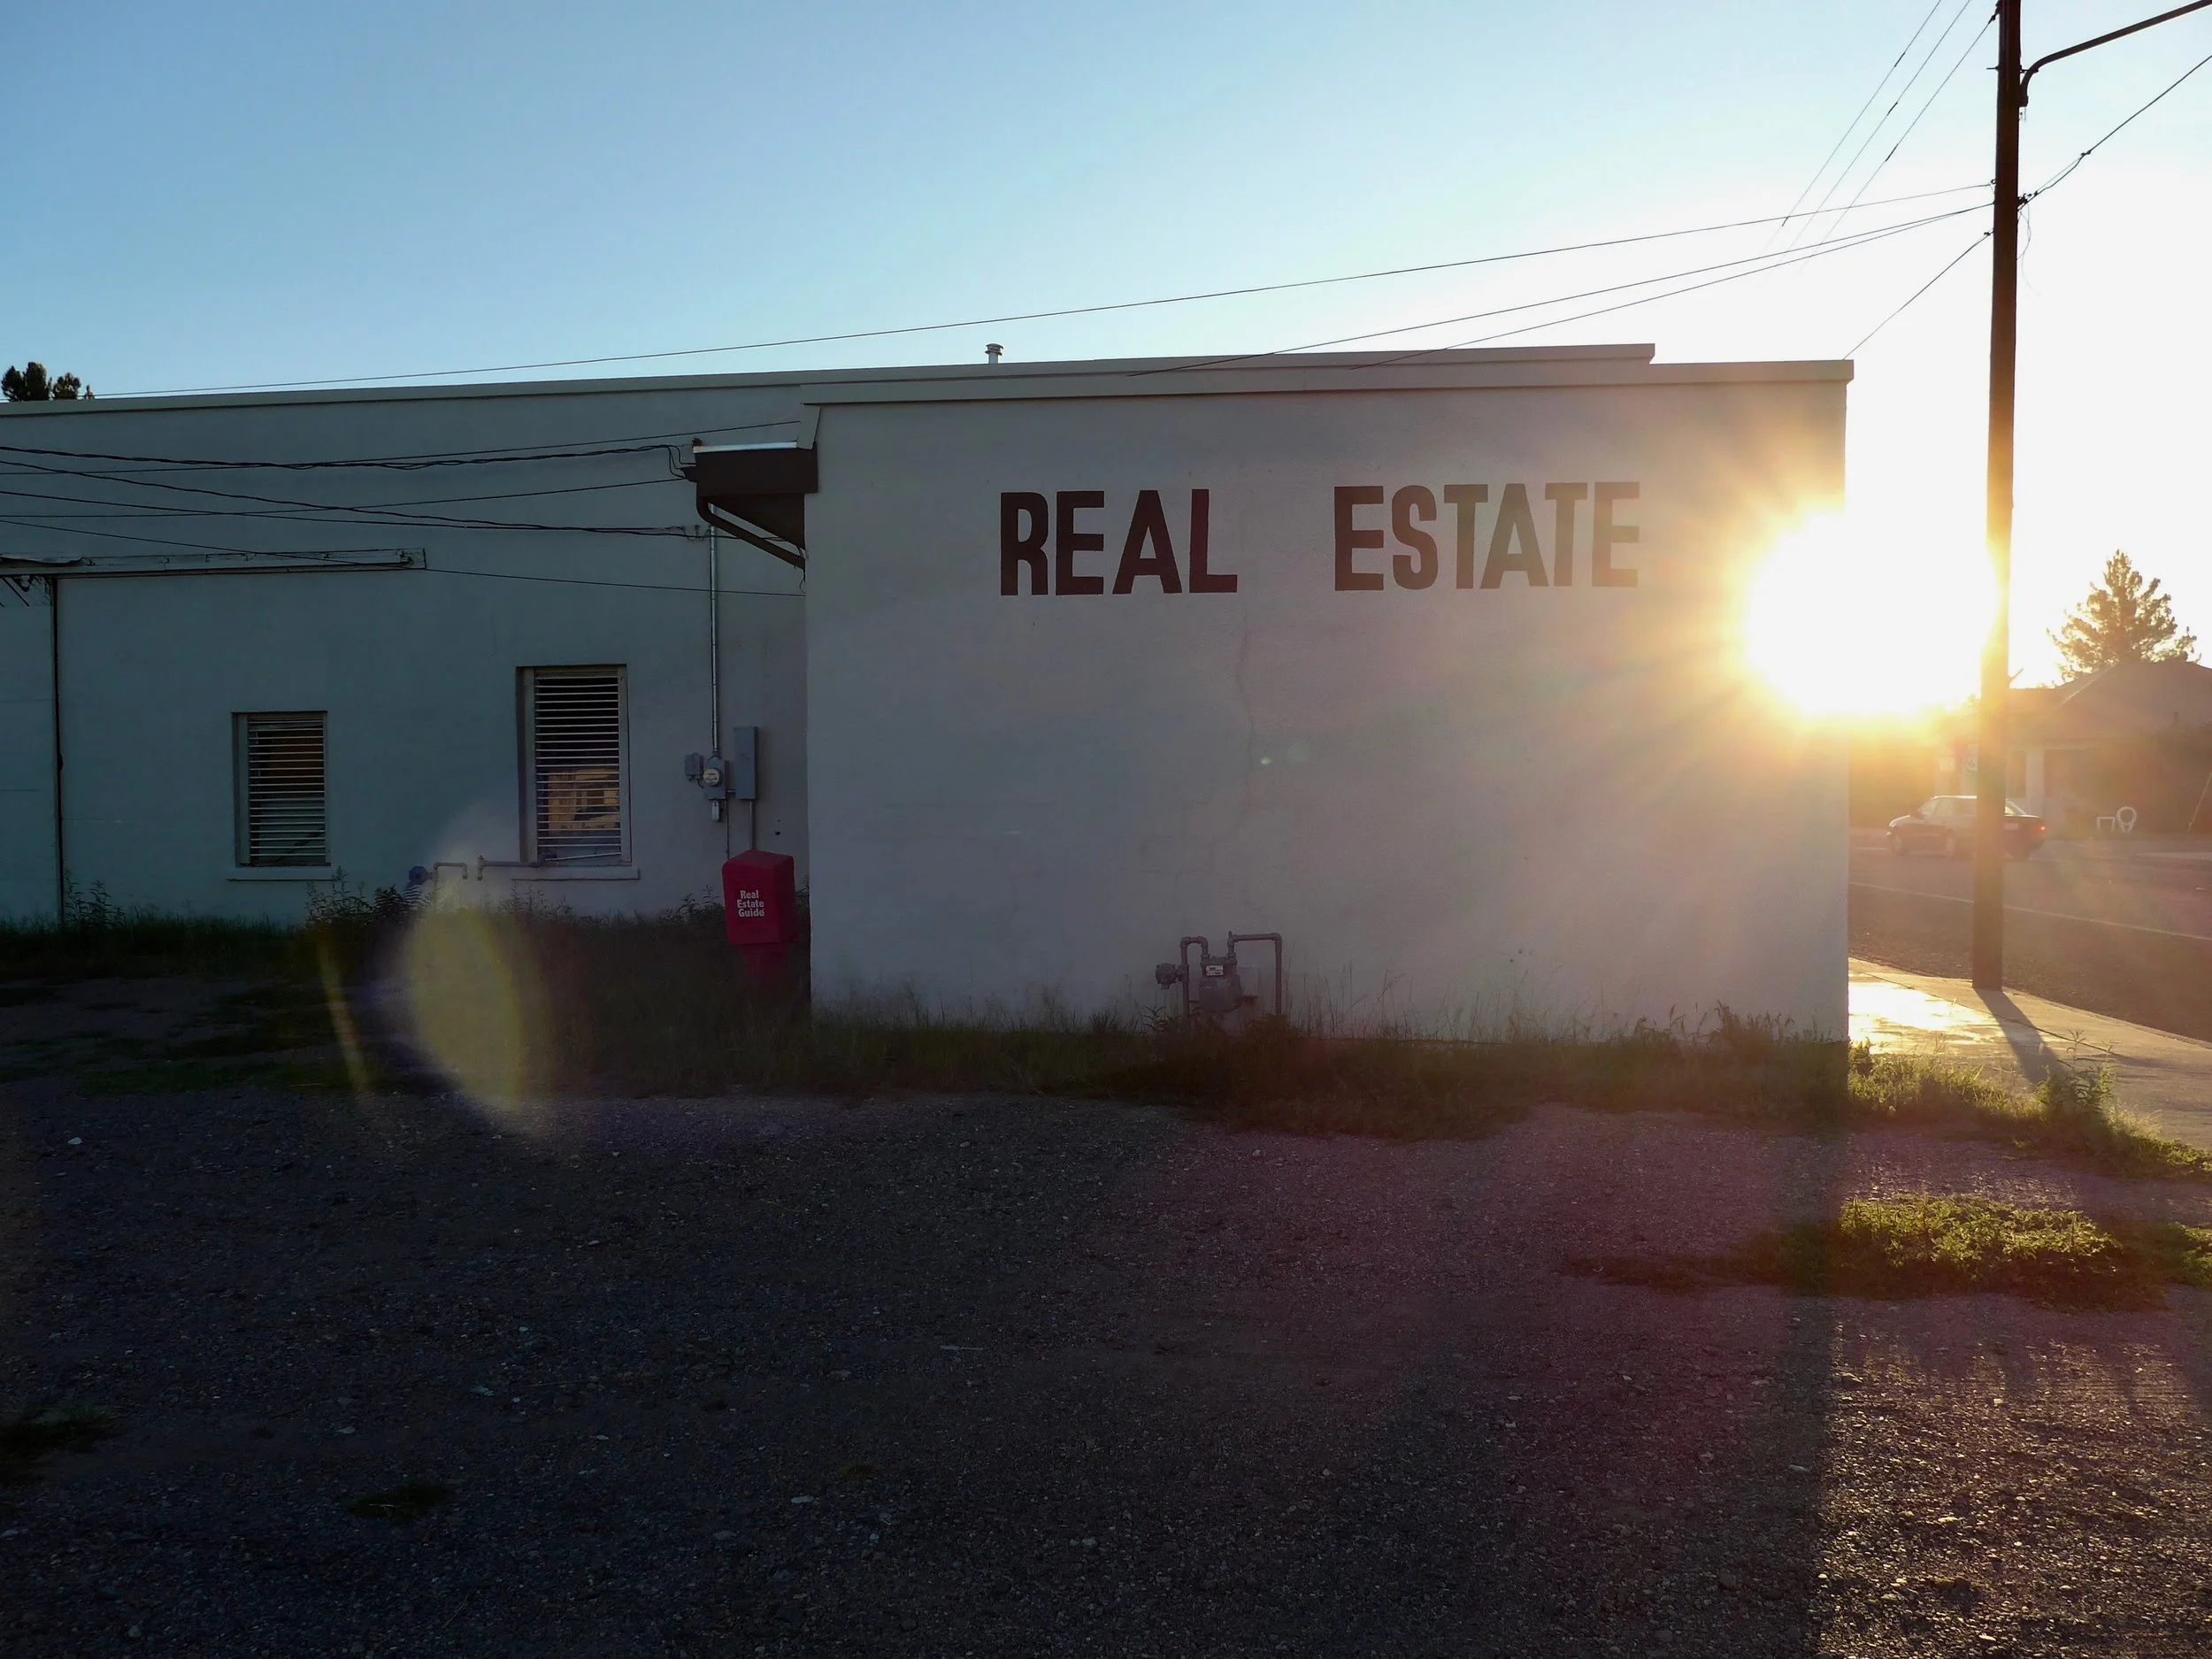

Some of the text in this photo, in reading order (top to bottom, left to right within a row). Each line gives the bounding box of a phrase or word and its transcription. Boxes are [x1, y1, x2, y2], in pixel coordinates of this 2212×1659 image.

[1001, 481, 1640, 595] REAL ESTATE
[740, 890, 759, 899] Real
[736, 899, 764, 908] Estate
[738, 908, 764, 917] Guide
